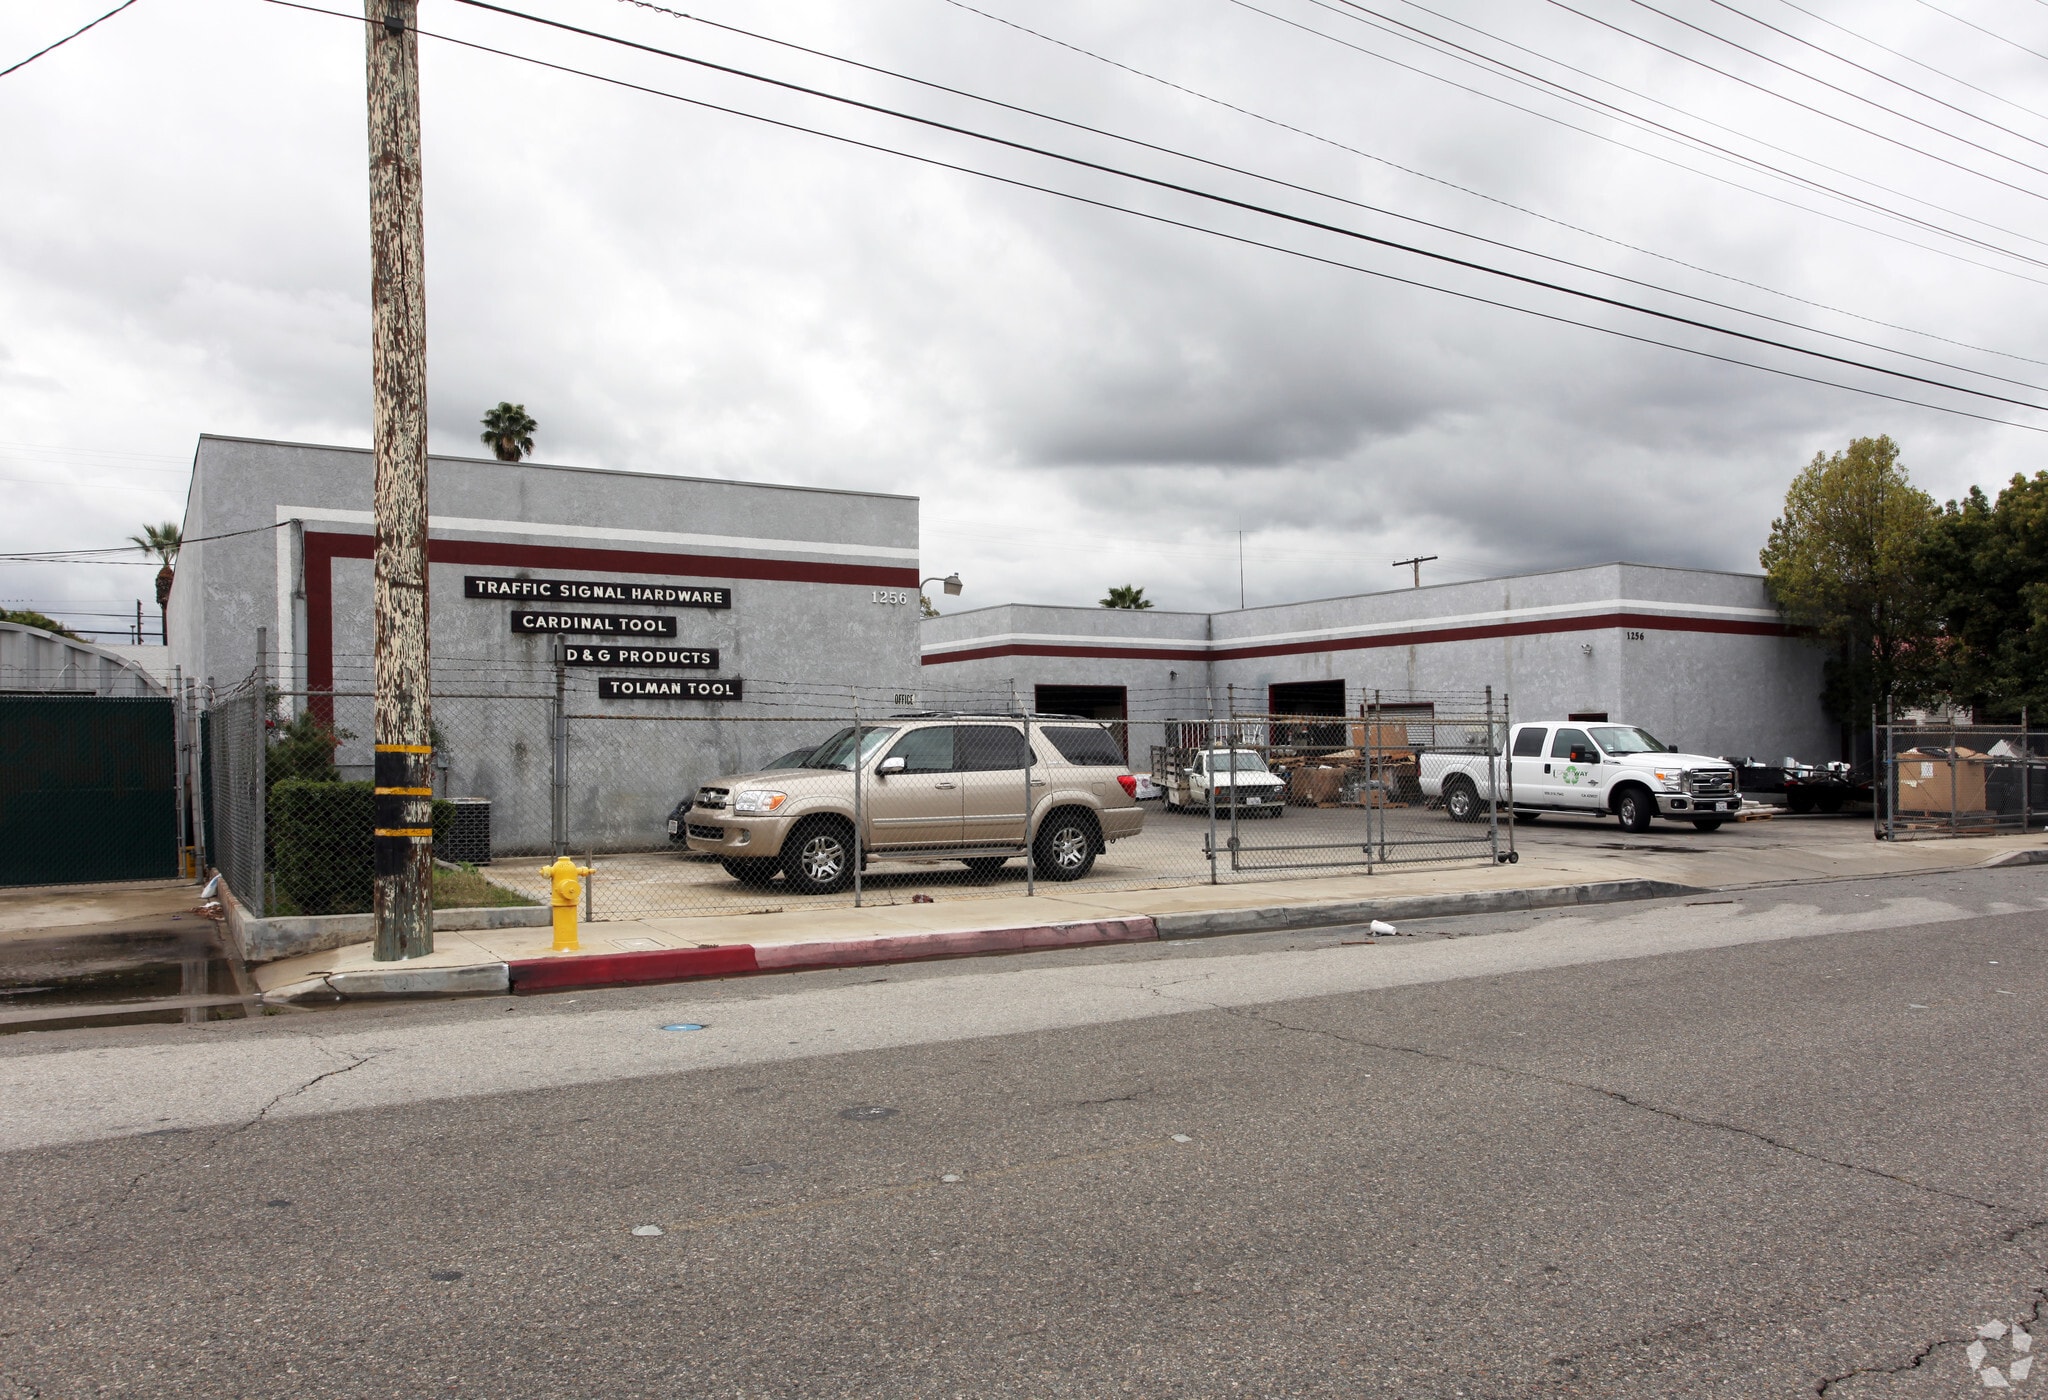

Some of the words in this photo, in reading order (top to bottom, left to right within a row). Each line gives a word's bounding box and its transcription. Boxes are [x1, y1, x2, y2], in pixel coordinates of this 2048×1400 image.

[476, 580, 552, 596] TRAFFIC
[560, 584, 626, 600] SIGNAL
[631, 588, 723, 604] HARDWARE
[871, 590, 907, 605] 1256
[522, 615, 614, 631] CARDINAL
[619, 618, 667, 633] TOOL
[1626, 631, 1645, 641] 1256
[619, 650, 711, 664] PRODUCTS
[611, 681, 681, 695] TOLMAN
[687, 682, 735, 696] TOOL
[894, 693, 914, 706] OFFICE
